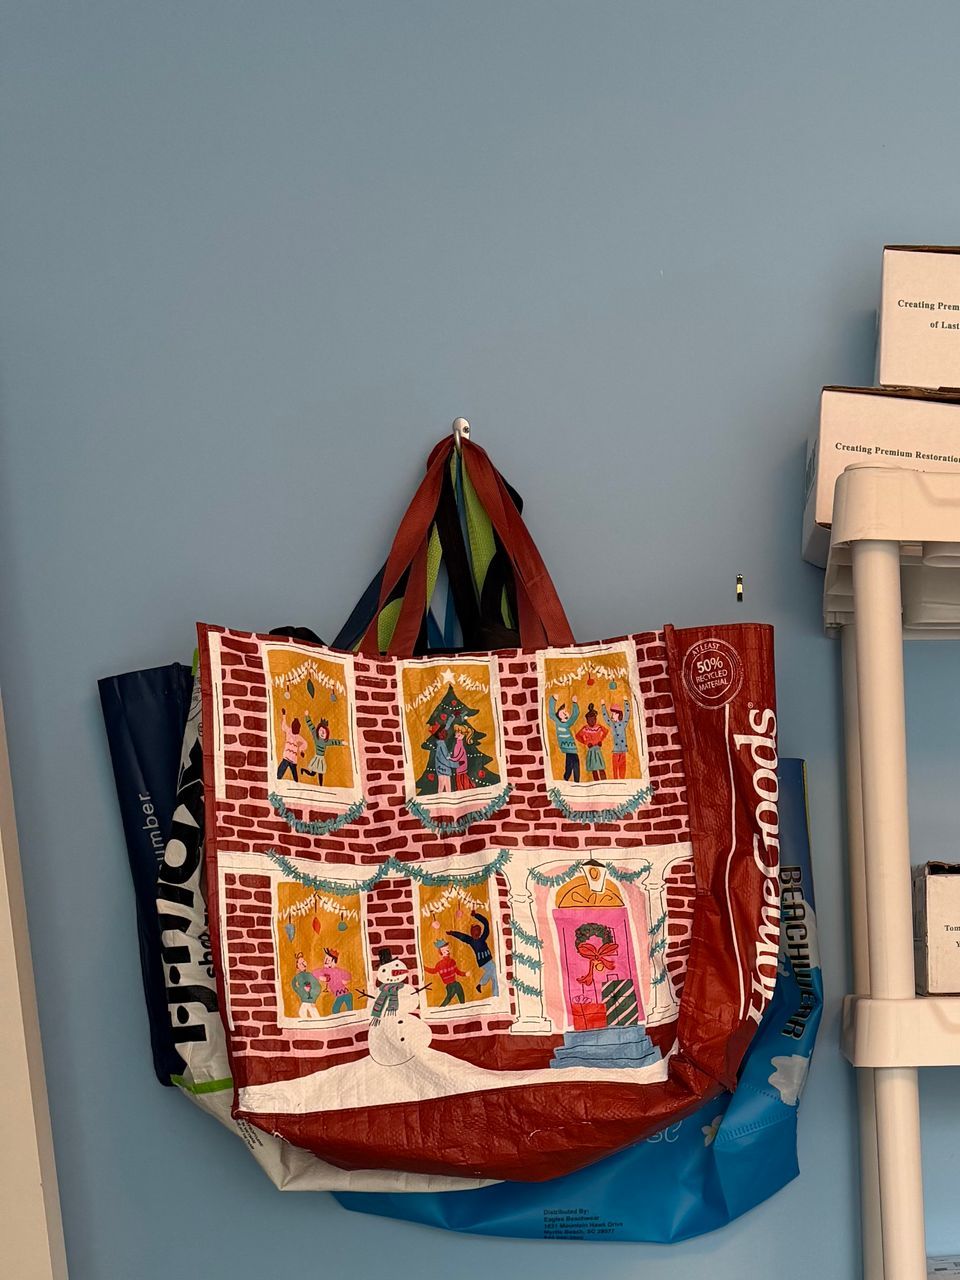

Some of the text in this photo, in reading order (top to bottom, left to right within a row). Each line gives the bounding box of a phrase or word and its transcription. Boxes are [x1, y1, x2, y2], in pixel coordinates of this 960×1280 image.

[897, 299, 935, 311] Creating
[930, 320, 939, 329] of
[835, 442, 872, 454] Creating
[875, 446, 913, 458] Premium
[691, 642, 720, 656] AT LEAST
[696, 656, 723, 673] 50%
[695, 669, 728, 683] RECYCLED
[698, 678, 728, 691] MATERIAL
[733, 708, 779, 1025] HomeGoods
[780, 865, 816, 1041] BEACHWEAR
